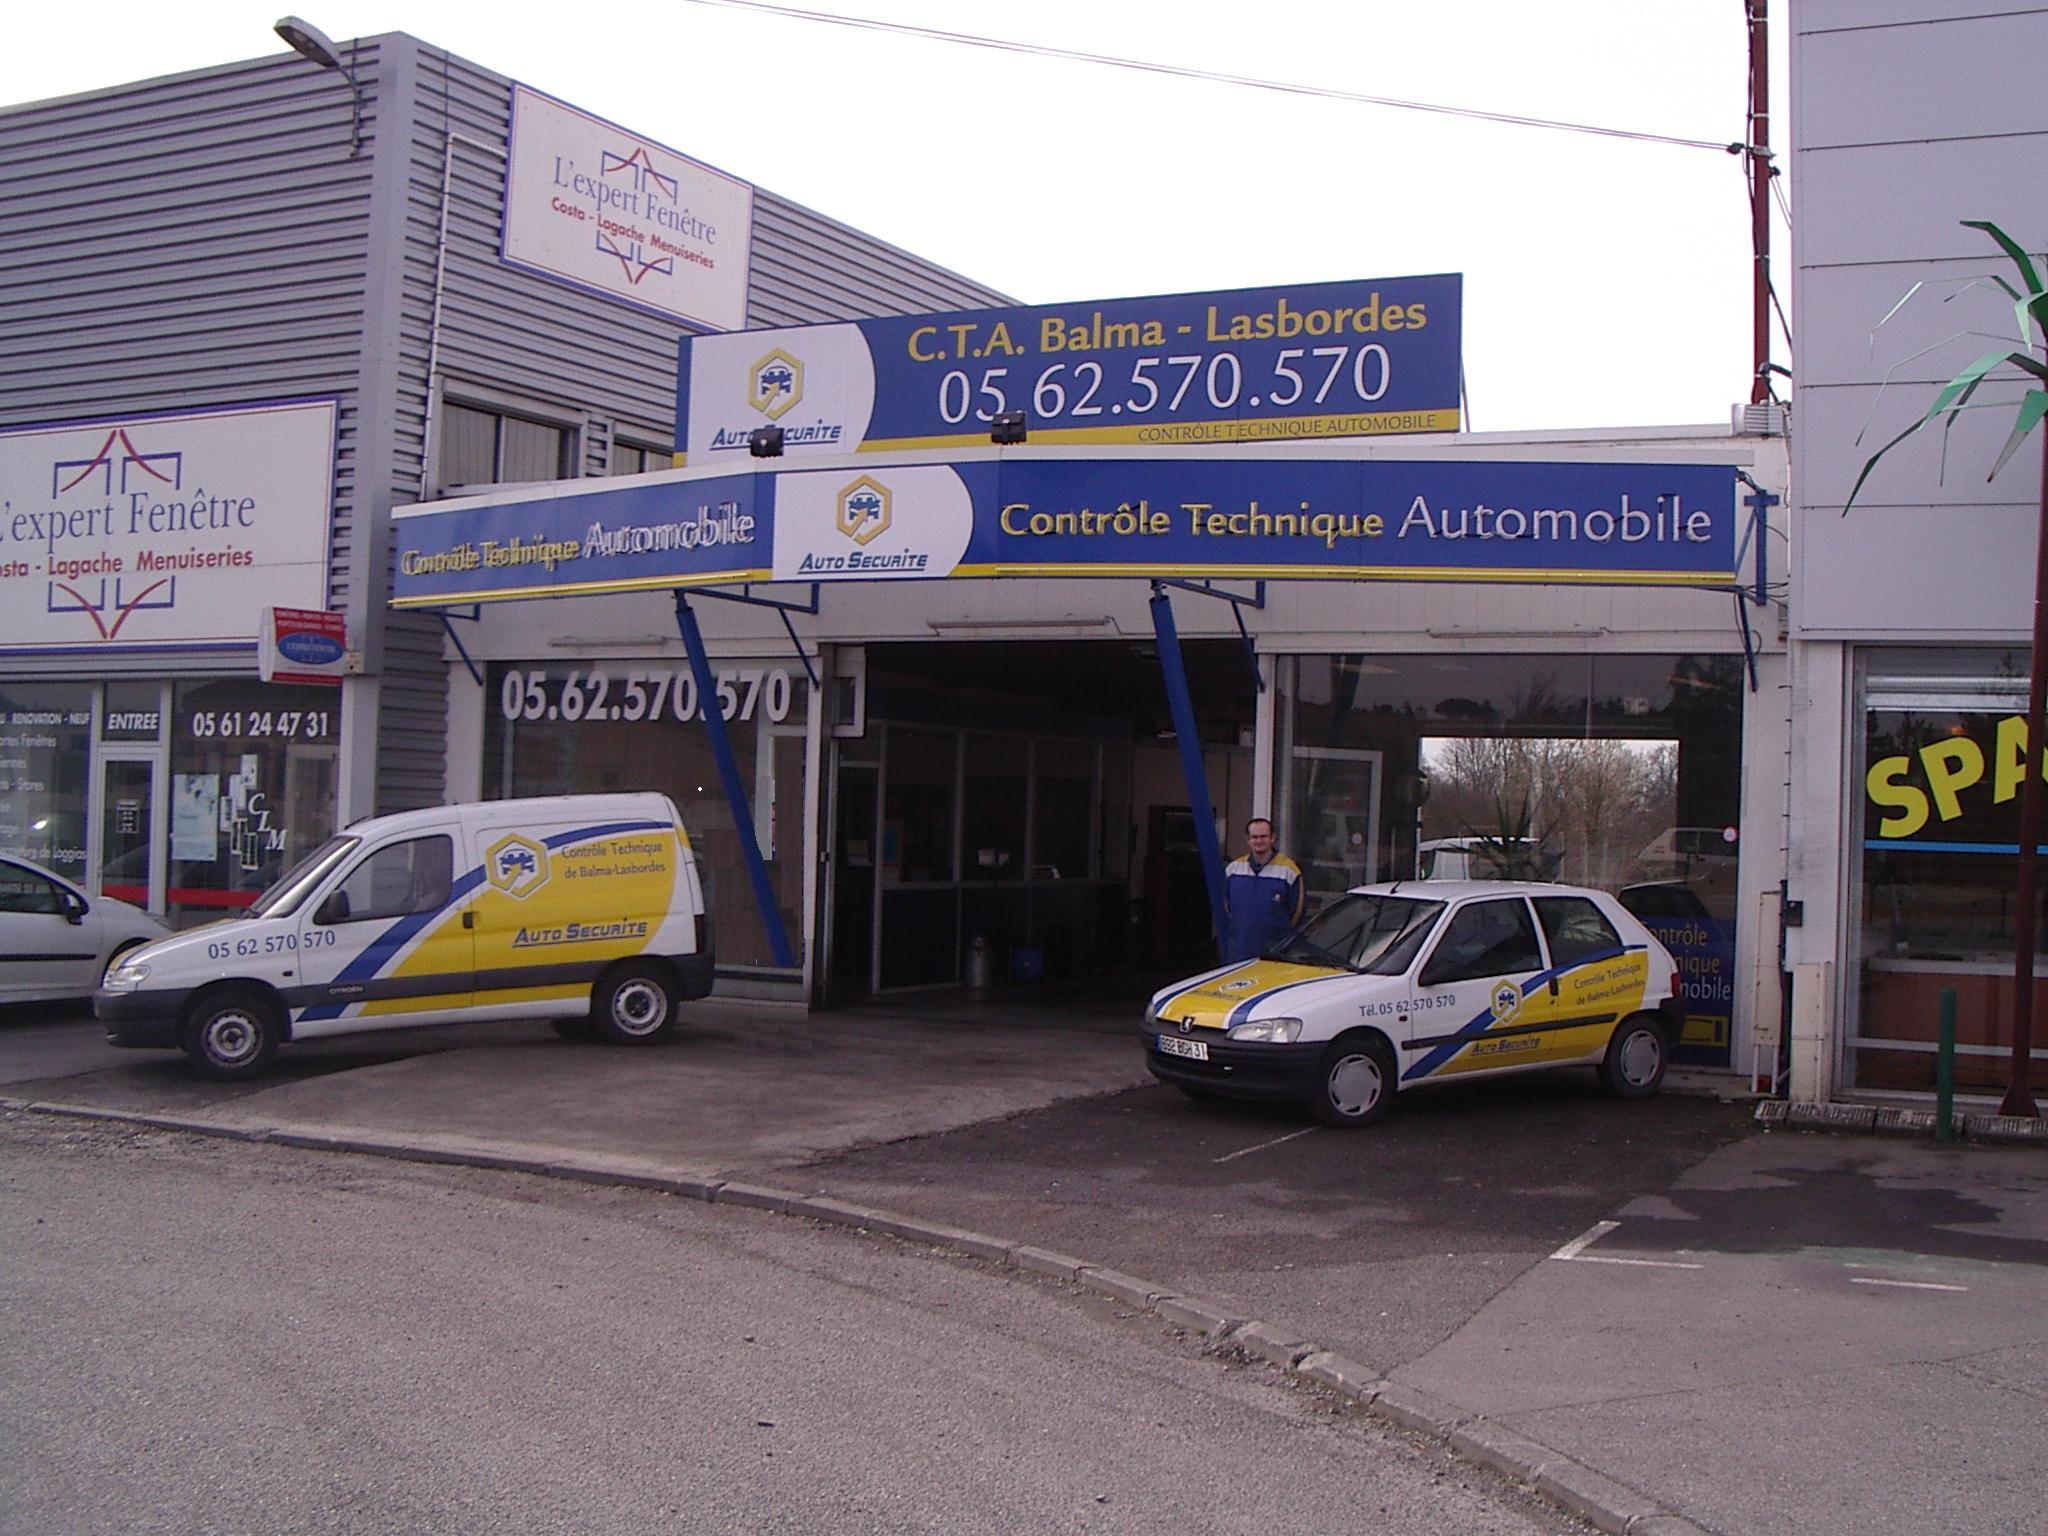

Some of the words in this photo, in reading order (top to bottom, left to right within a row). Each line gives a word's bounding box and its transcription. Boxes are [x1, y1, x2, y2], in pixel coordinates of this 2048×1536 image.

[553, 155, 639, 215] L'expert
[646, 192, 717, 245] Fenêtre
[552, 196, 585, 221] Costa
[597, 214, 645, 243] Lagache
[650, 232, 714, 269] Menuiseries
[907, 321, 1025, 362] C.T.A.
[1040, 312, 1166, 354] Balma
[1206, 291, 1428, 343] Lasbordes
[939, 343, 1391, 424] 0562.570.570
[1138, 423, 1222, 442] CONTRÔLE
[1225, 419, 1323, 438] TECHNIQUE
[1326, 414, 1436, 433] AUTOMOBILE
[0, 499, 114, 554] 'expert
[127, 487, 256, 535] Fenêtre
[1000, 499, 1171, 538] Contrôle
[1180, 501, 1385, 550] Technique
[1397, 493, 1713, 544] Automobile
[480, 533, 580, 572] Technique
[583, 501, 756, 560] Automobile
[48, 551, 123, 580] Lagache
[136, 545, 253, 572] Menuiseries
[799, 552, 846, 570] AUTO
[107, 712, 160, 731] ENTREE
[193, 712, 216, 737] 05
[220, 712, 242, 737] 61
[249, 712, 272, 737] 24
[276, 712, 302, 737] 47
[306, 712, 329, 736] 31
[561, 843, 607, 860] Contrôle
[609, 839, 664, 857] Technique
[564, 866, 577, 879] de
[579, 860, 667, 879] Balma-Lasbordes
[208, 943, 231, 959] 05
[237, 939, 258, 956] 62
[265, 934, 298, 953] 570
[303, 930, 336, 948] 570
[514, 926, 562, 944] AUTO
[1642, 921, 1708, 947] ontrôle
[1396, 1000, 1410, 1013] 62
[1413, 998, 1434, 1011] 570
[1436, 994, 1457, 1008] 570
